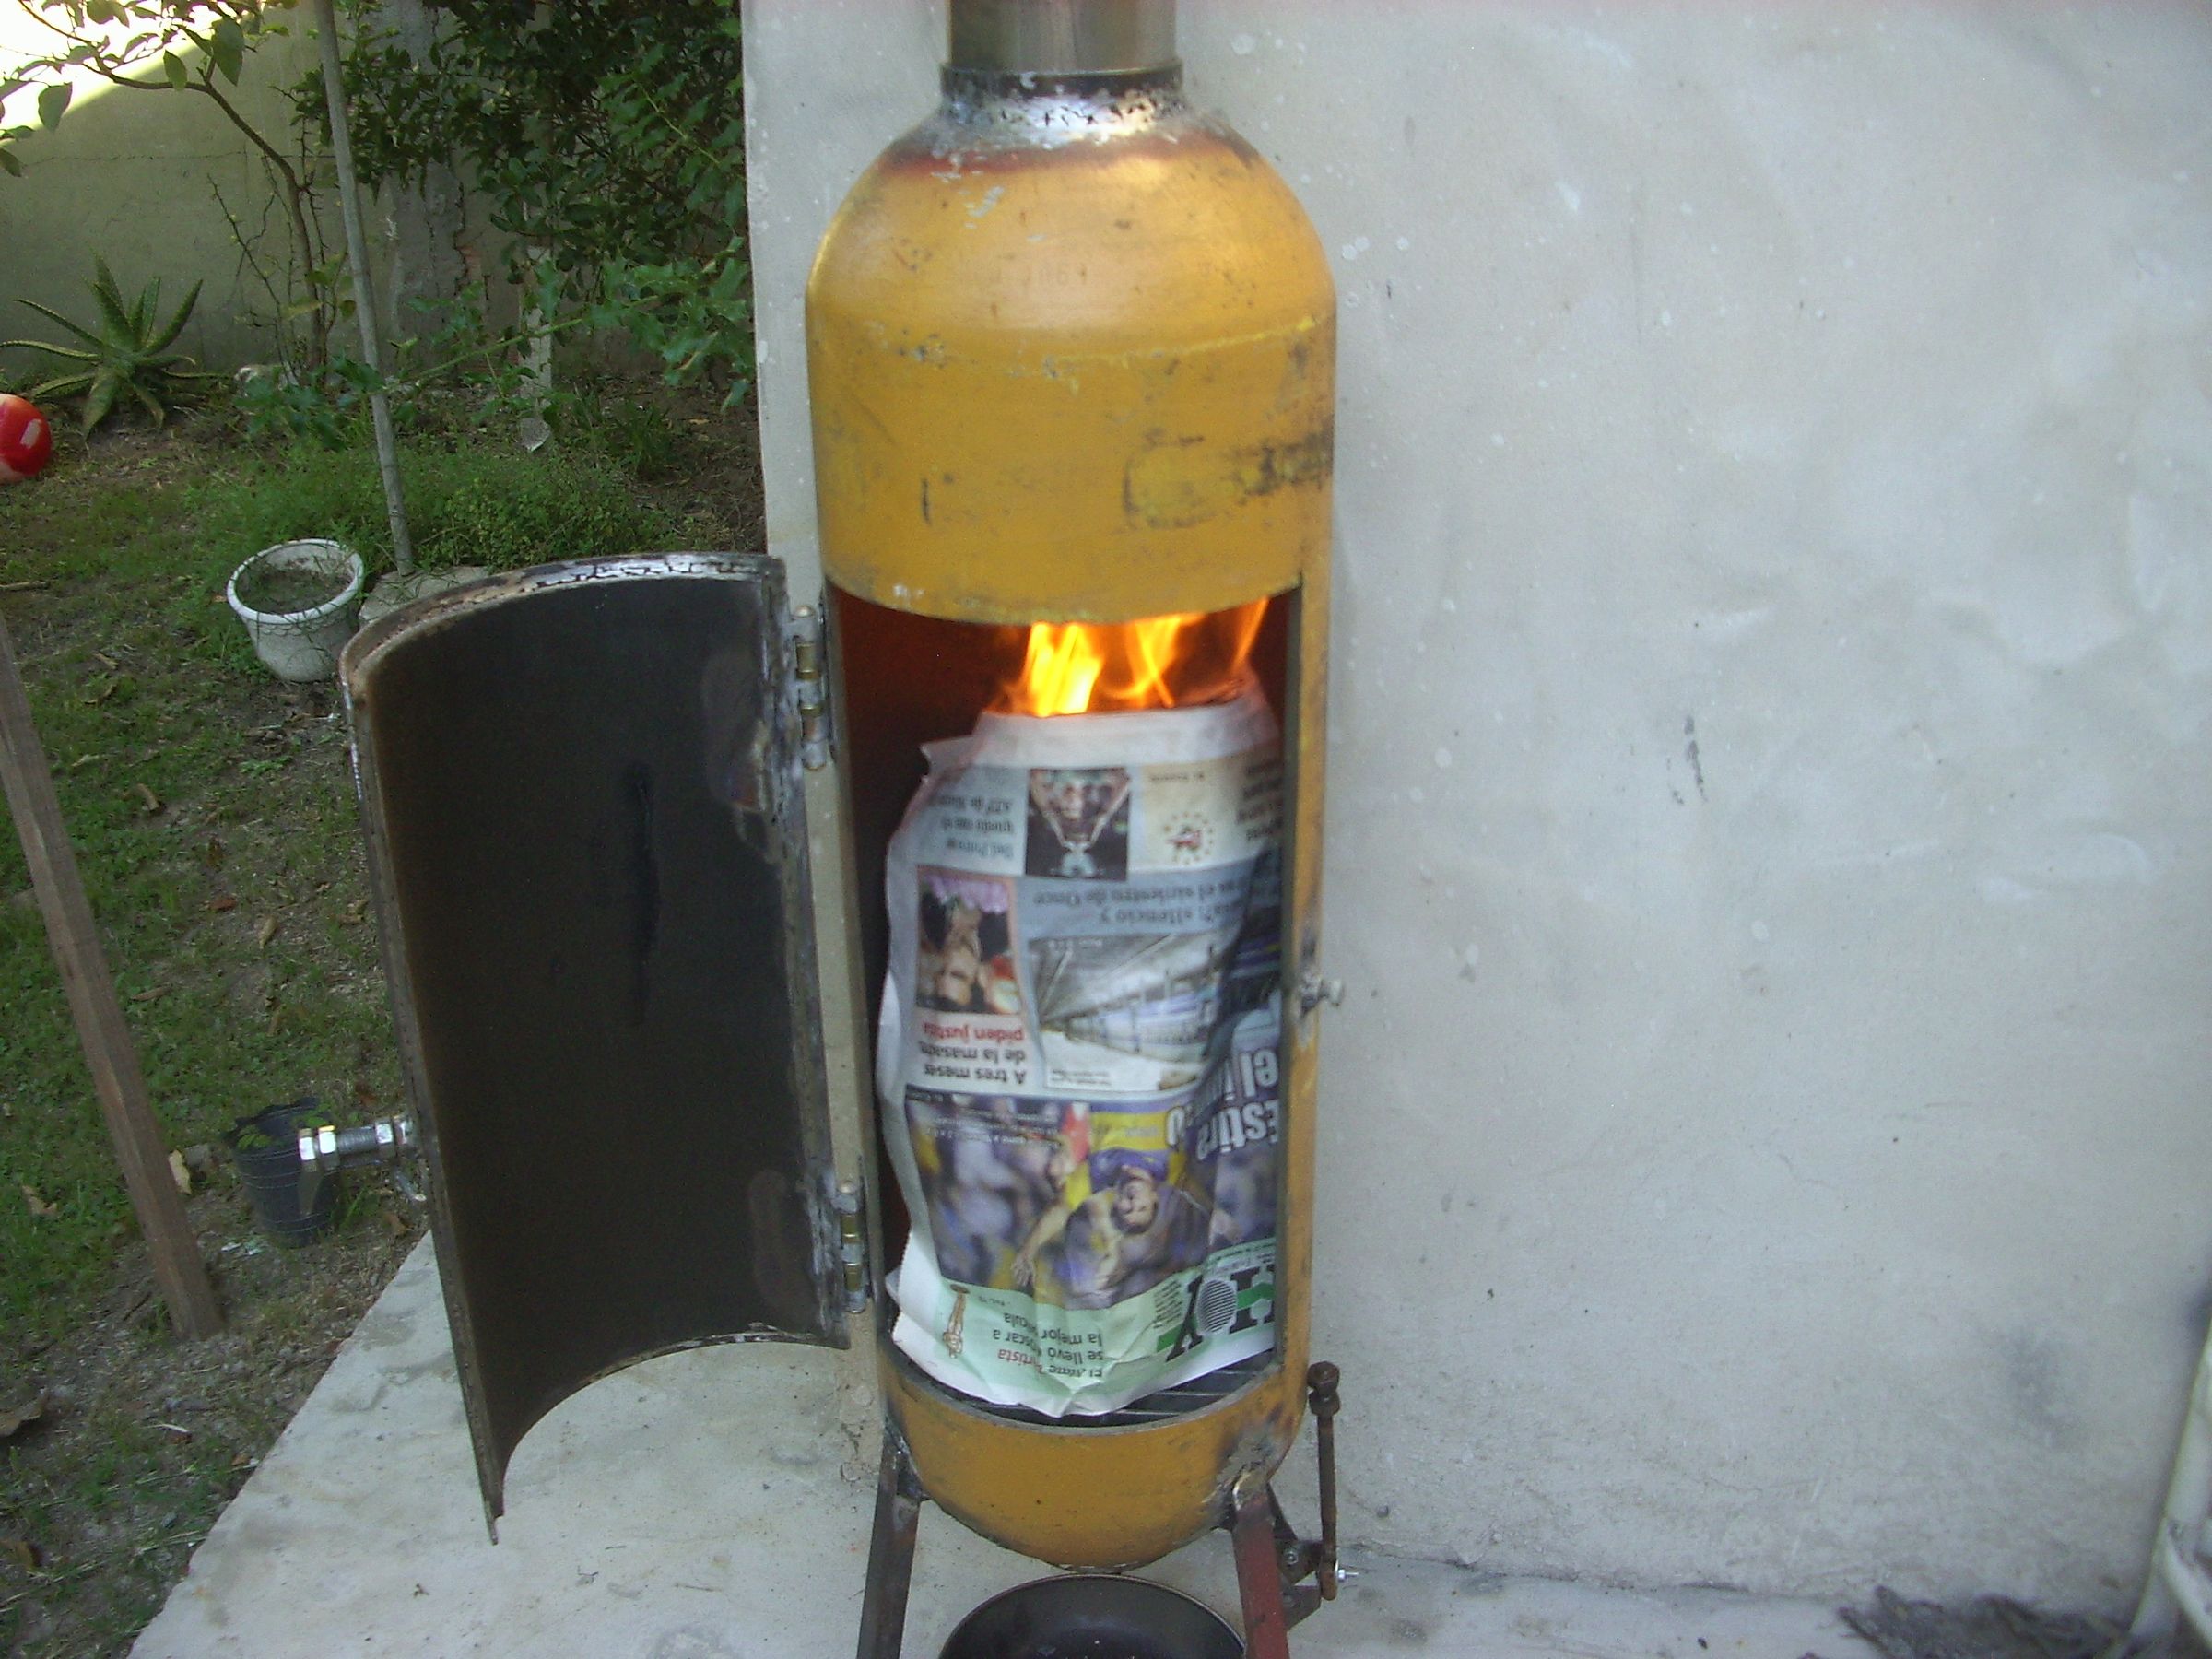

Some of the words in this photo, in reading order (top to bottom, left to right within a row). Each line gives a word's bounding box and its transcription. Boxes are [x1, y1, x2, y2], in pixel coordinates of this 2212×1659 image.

[974, 1028, 1024, 1045] piden
[982, 1049, 999, 1065] la
[1005, 1051, 1026, 1066] de
[924, 1065, 971, 1079] meses
[975, 1069, 1008, 1083] tres
[1015, 1071, 1026, 1085] A
[1239, 1049, 1279, 1098] el
[993, 1330, 1001, 1340] a
[1041, 1328, 1082, 1346] mejor
[1088, 1333, 1103, 1347] la
[1047, 1347, 1083, 1364] llevó
[1088, 1350, 1104, 1361] se
